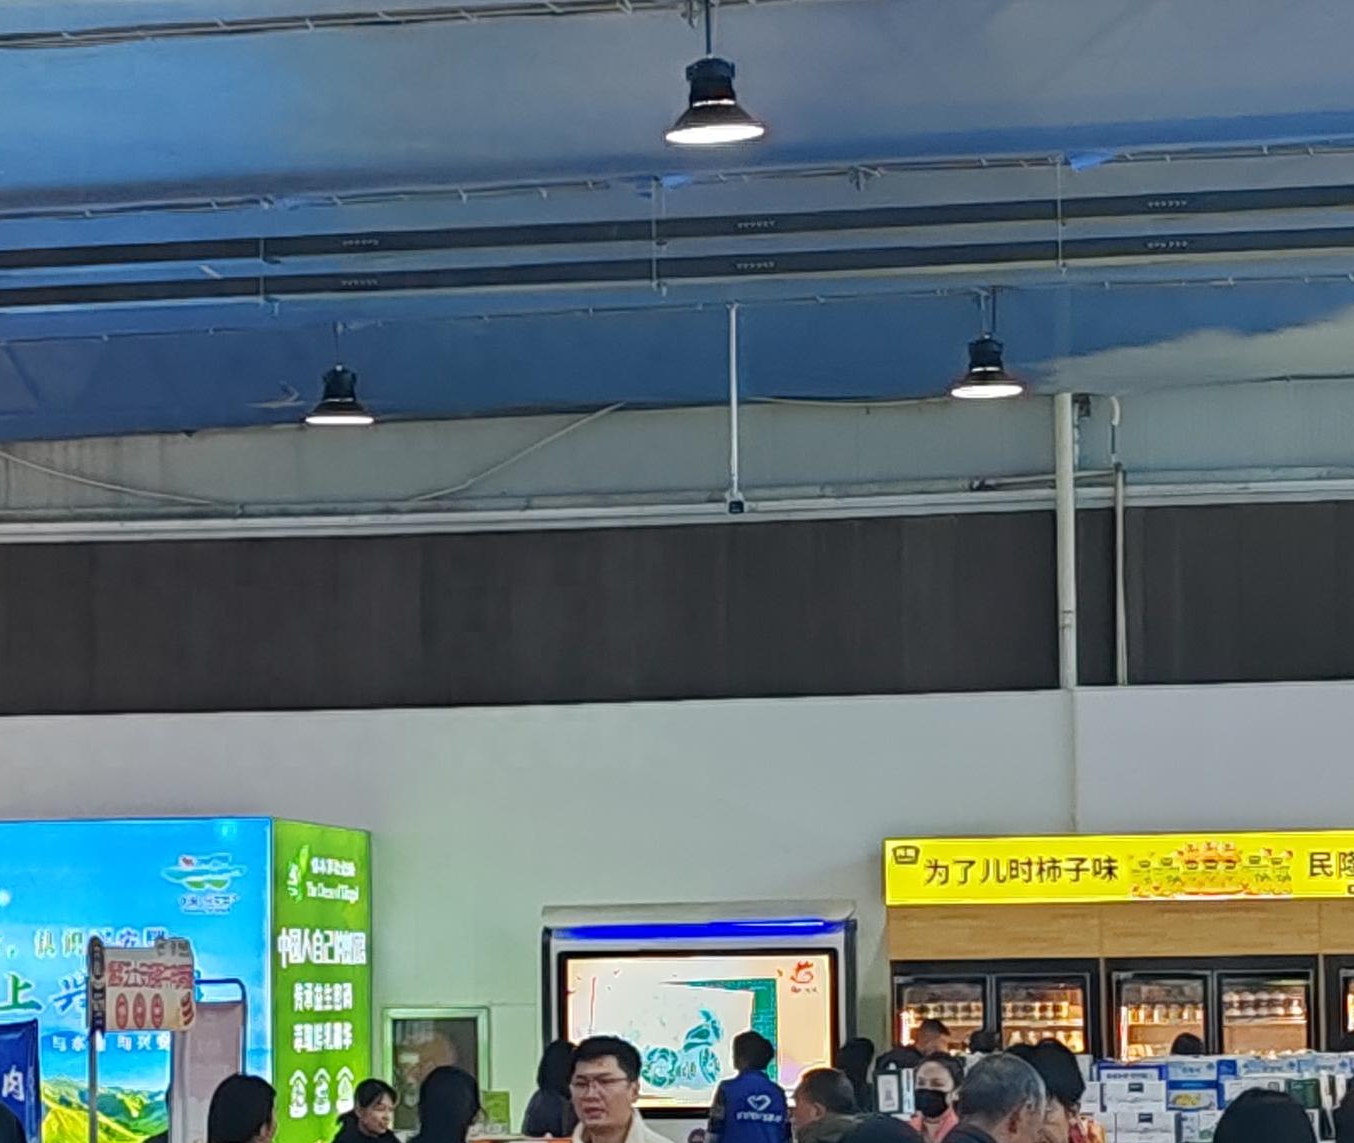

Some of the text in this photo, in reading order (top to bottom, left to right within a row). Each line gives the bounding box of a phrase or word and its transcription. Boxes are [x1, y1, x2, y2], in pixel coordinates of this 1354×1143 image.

[924, 855, 1120, 887] 为了儿时柿子味
